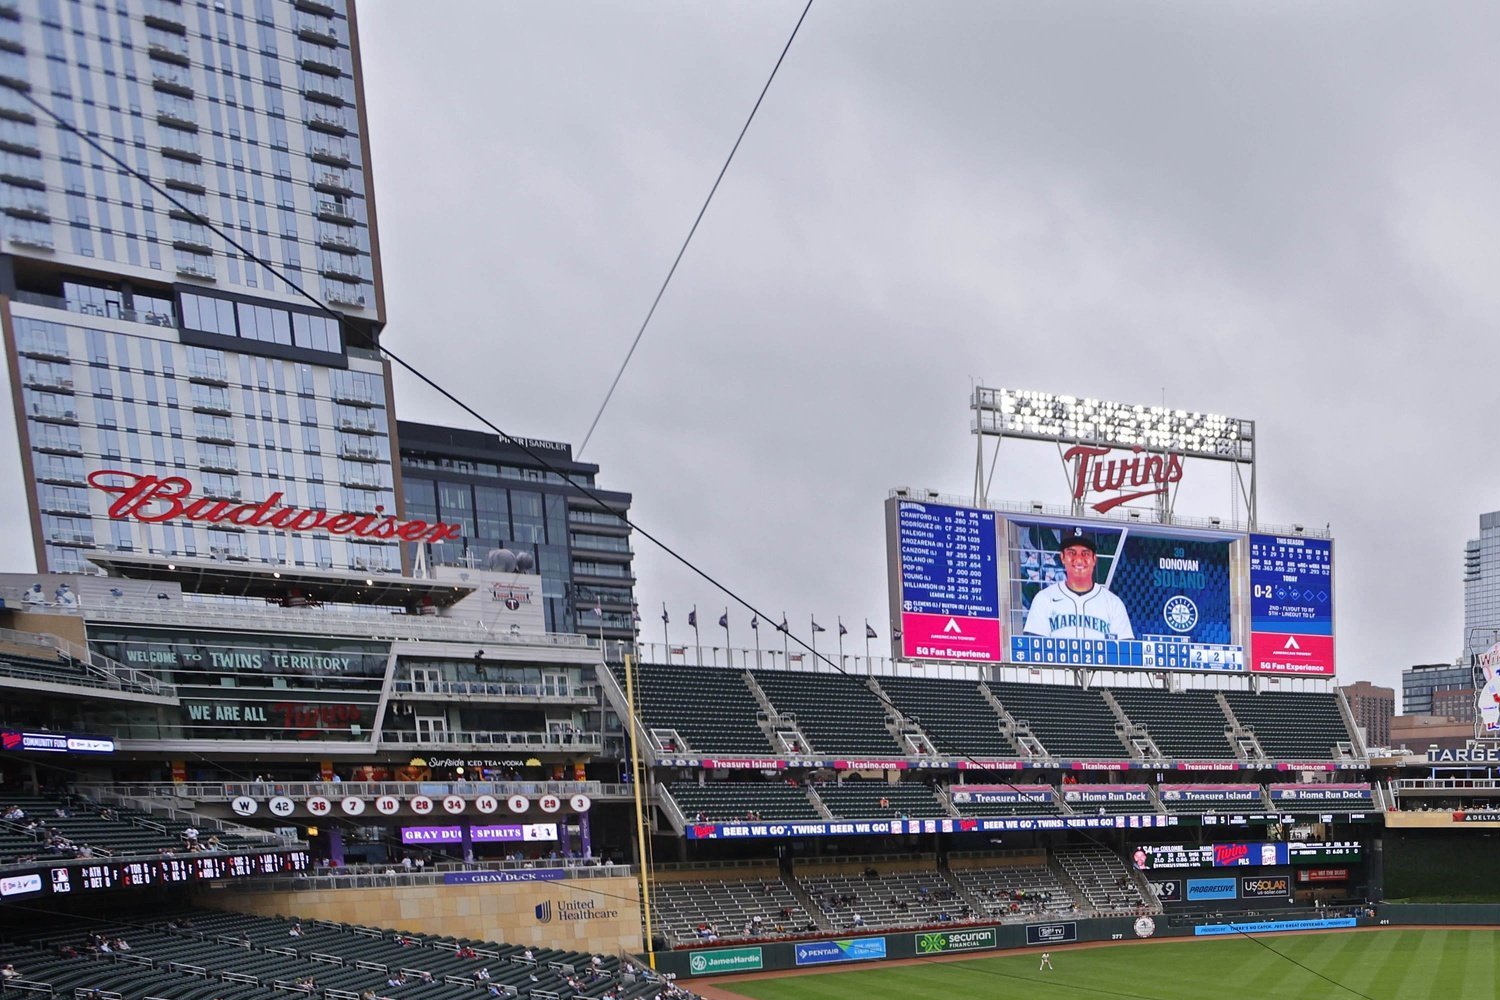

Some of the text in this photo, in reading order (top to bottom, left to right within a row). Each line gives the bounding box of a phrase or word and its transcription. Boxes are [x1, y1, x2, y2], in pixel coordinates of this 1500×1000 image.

[529, 439, 566, 451] SANDLER
[1064, 445, 1183, 513] Twins
[88, 470, 460, 543] Budweiser
[901, 512, 931, 521] CRAWFORD
[902, 529, 925, 538] RALEIGH
[1287, 538, 1304, 546] SEASON
[1174, 548, 1184, 558] 39
[1160, 558, 1199, 572] DONOVAN
[1153, 570, 1205, 590] SOLANO
[904, 582, 937, 590] WILLIAMSON
[1254, 585, 1272, 598] 0-2
[916, 647, 990, 658] 5G Fan Experience
[126, 650, 177, 664] WELCOME
[210, 652, 262, 669] TWINS
[272, 652, 350, 670] TERRITORY
[1272, 662, 1285, 670] Fan
[1286, 663, 1324, 672] Experience
[189, 705, 211, 720] WE
[215, 706, 240, 721] ARE
[244, 706, 267, 722] ALL
[429, 757, 465, 767] Surfside
[712, 760, 750, 769] Treasure
[752, 759, 777, 769] Island
[965, 762, 997, 770] Treasure
[975, 793, 1045, 803] Treasure Island
[1082, 793, 1107, 801] Home
[1128, 792, 1146, 800] Deck
[1185, 792, 1252, 800] Treasure Island
[1300, 791, 1363, 799] Home Run Deck
[275, 802, 289, 811] 42
[311, 801, 327, 812] 36
[350, 800, 357, 811] 7
[381, 800, 394, 811] 10
[415, 800, 429, 810] 28
[448, 799, 462, 810] 34
[481, 799, 492, 810] 14
[516, 799, 522, 809] 6
[544, 799, 557, 809] 29
[577, 798, 584, 808] 3
[405, 829, 438, 840] GRAY
[476, 828, 522, 839] SPIRITS
[723, 825, 749, 836] BEER
[751, 825, 767, 835] WE
[791, 824, 826, 834] TWINS!
[830, 823, 856, 834] BEER
[858, 823, 871, 833] WE
[873, 823, 889, 833] GO!
[1214, 844, 1248, 865] Twins
[472, 872, 537, 883] GRAY DUCK
[1189, 885, 1235, 893] PROGRESSIVE
[557, 899, 594, 911] United
[558, 909, 618, 922] Healthcare
[948, 931, 991, 943] securian
[808, 948, 839, 957] PENTAIR
[708, 955, 760, 966] JamesHardie
